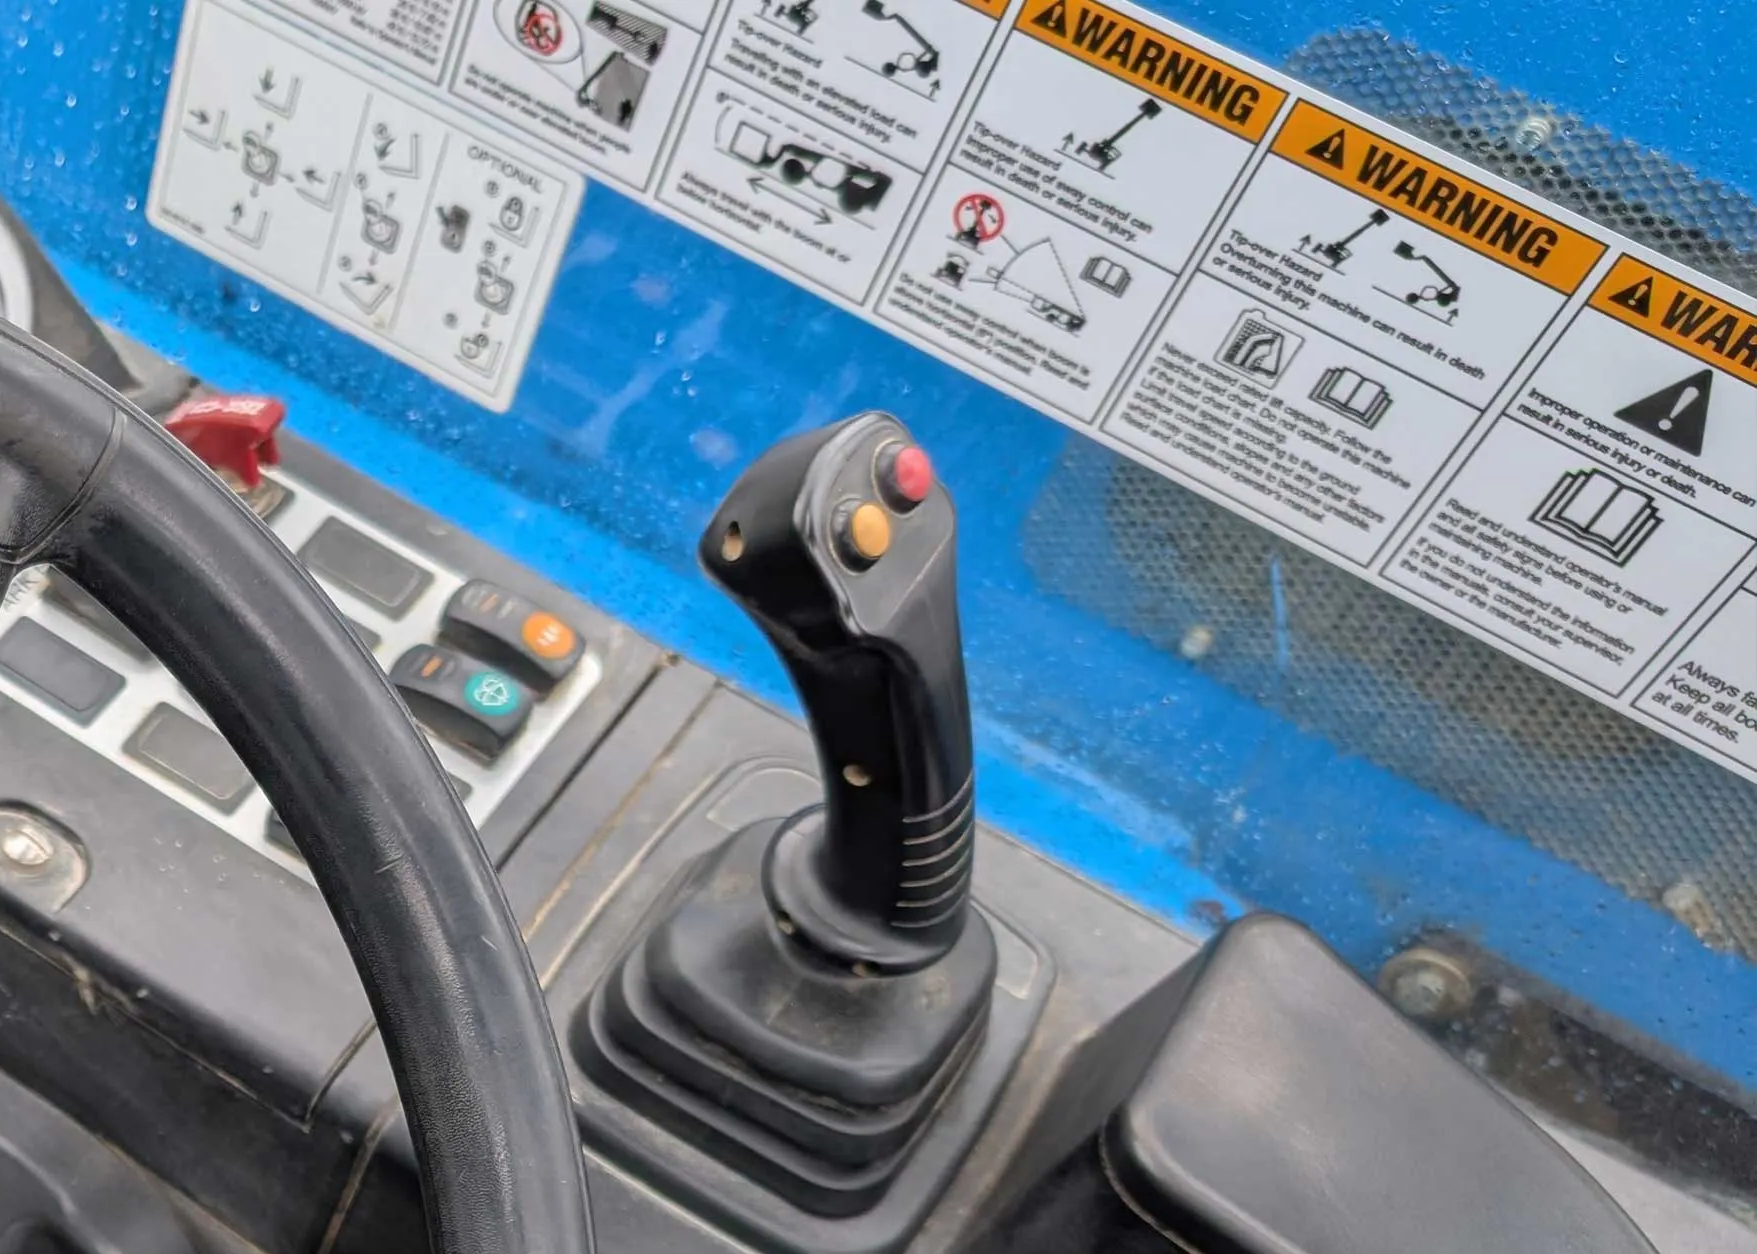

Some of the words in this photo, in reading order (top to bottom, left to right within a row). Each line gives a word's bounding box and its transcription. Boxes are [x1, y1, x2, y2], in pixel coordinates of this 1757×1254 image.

[1065, 8, 1259, 125] WARNING
[466, 145, 543, 194] OPTIONAL
[1356, 144, 1556, 267] WARNING
[1227, 263, 1273, 290] serious
[1229, 228, 1277, 259] Tip-over
[1278, 254, 1323, 282] Hazard
[1219, 242, 1292, 285] Overturning
[1293, 278, 1316, 296] this
[1317, 292, 1371, 323] machine
[1371, 319, 1396, 336] can
[1396, 331, 1434, 354] result
[1448, 357, 1485, 379] death
[1660, 290, 1757, 372] WAR
[1517, 403, 1553, 425] result
[1564, 427, 1610, 454] serious
[1610, 447, 1646, 472] injury
[1527, 387, 1582, 420] Improper
[1582, 416, 1639, 449] operation
[1654, 452, 1731, 494] maintenance
[1731, 490, 1757, 507] can
[1428, 522, 1492, 560] maintaining
[1436, 511, 1462, 527] and
[1476, 531, 1512, 553] safety
[1512, 549, 1544, 570] signs
[1544, 564, 1583, 589] before
[1583, 586, 1617, 608] using
[1445, 497, 1478, 520] Read
[1477, 516, 1502, 532] and
[1501, 528, 1566, 564] understand
[1565, 561, 1621, 593] operator's
[1622, 589, 1668, 616] manual
[1399, 558, 1418, 573] the
[1418, 570, 1454, 590] owner
[1467, 593, 1487, 609] the
[1420, 554, 1440, 569] the
[1492, 593, 1535, 618] consult
[1533, 614, 1562, 631] your
[1424, 543, 1448, 558] you
[1465, 563, 1486, 577] not
[1485, 574, 1551, 610] understand
[1550, 605, 1570, 621] the
[1571, 616, 1635, 653] information
[1651, 691, 1672, 706] at
[1670, 701, 1694, 716] all
[1665, 673, 1711, 704] Keep
[1711, 700, 1736, 716] all
[1734, 709, 1757, 730] bo
[1677, 660, 1740, 697] Always
